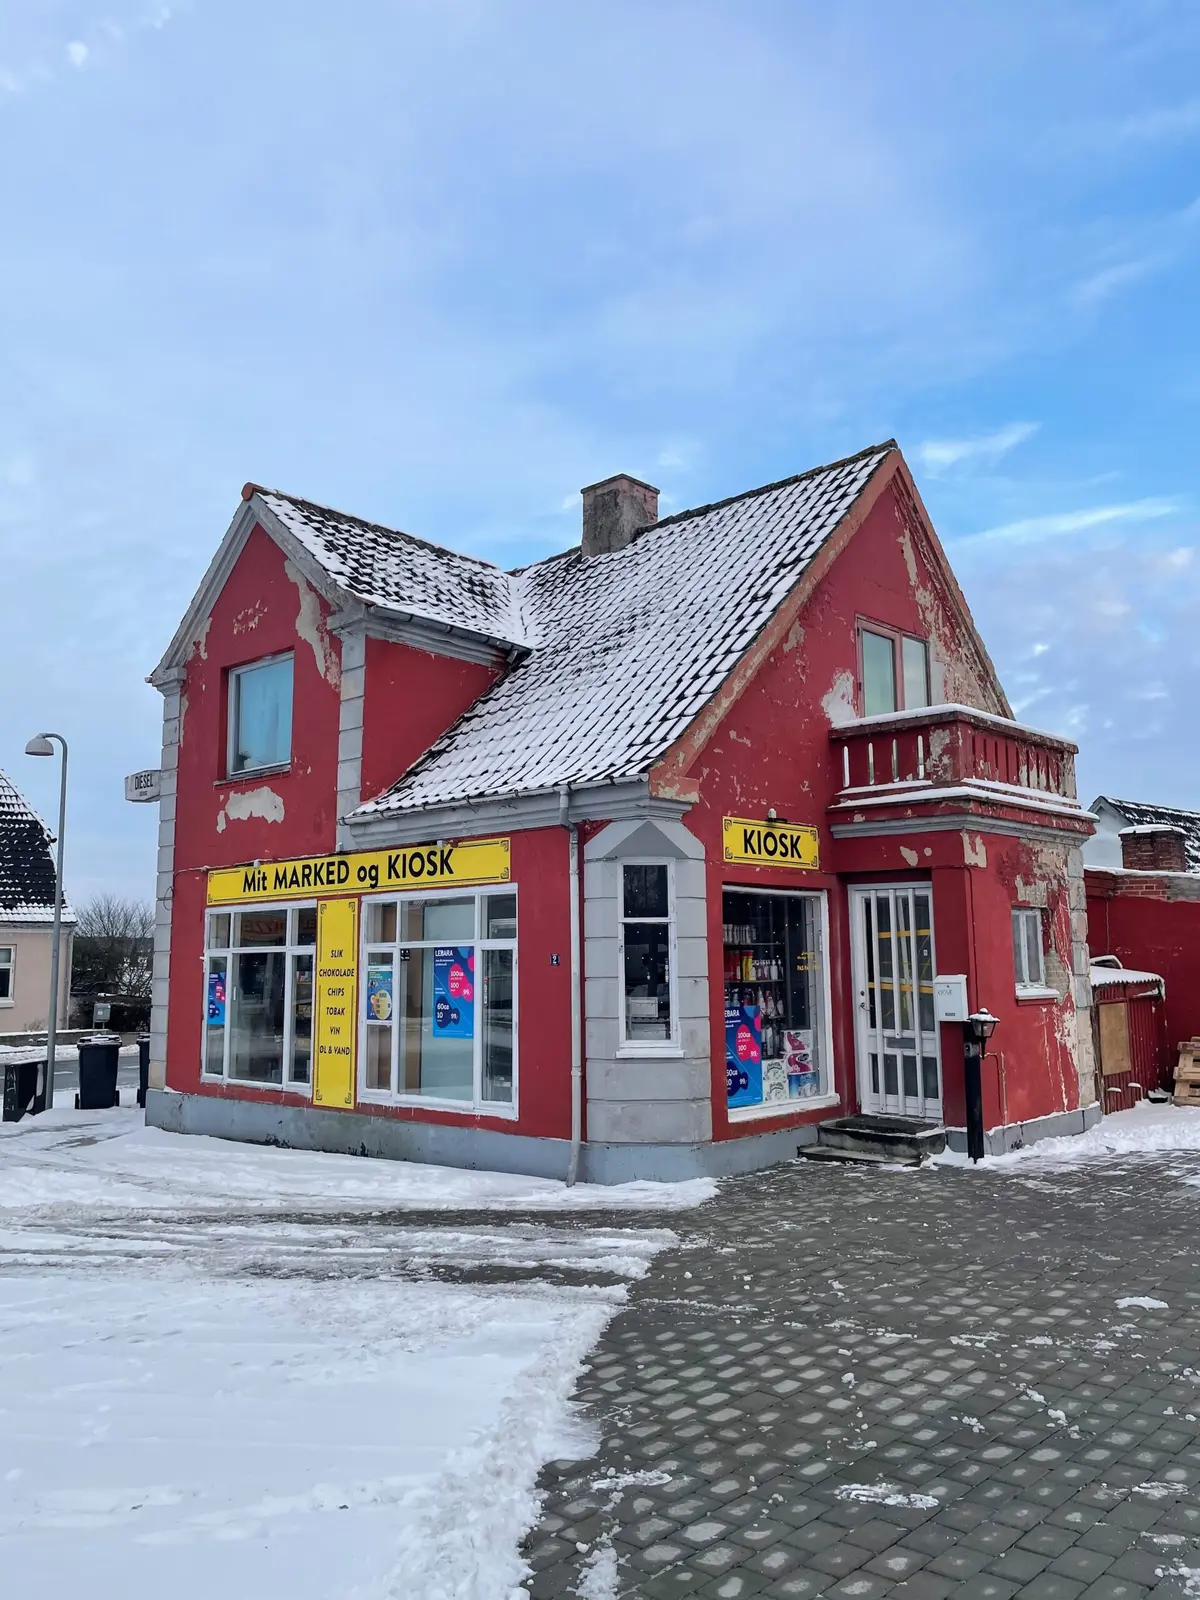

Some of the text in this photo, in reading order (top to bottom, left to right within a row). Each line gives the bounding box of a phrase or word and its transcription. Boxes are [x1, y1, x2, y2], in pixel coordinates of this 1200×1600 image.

[134, 774, 154, 790] DIESEL
[743, 828, 803, 859] KIOSK
[242, 848, 455, 893] Mit MARKED og KIOSK
[330, 949, 344, 958] SLIK
[435, 949, 454, 957] LEBARA
[318, 968, 355, 977] CHOKOLADE
[327, 987, 345, 997] CHIPS
[326, 1006, 346, 1016] TOBAK
[724, 1010, 740, 1018] EBARA
[329, 1026, 341, 1035] VIN
[328, 1045, 333, 1055] &
[334, 1046, 350, 1056] VAND
